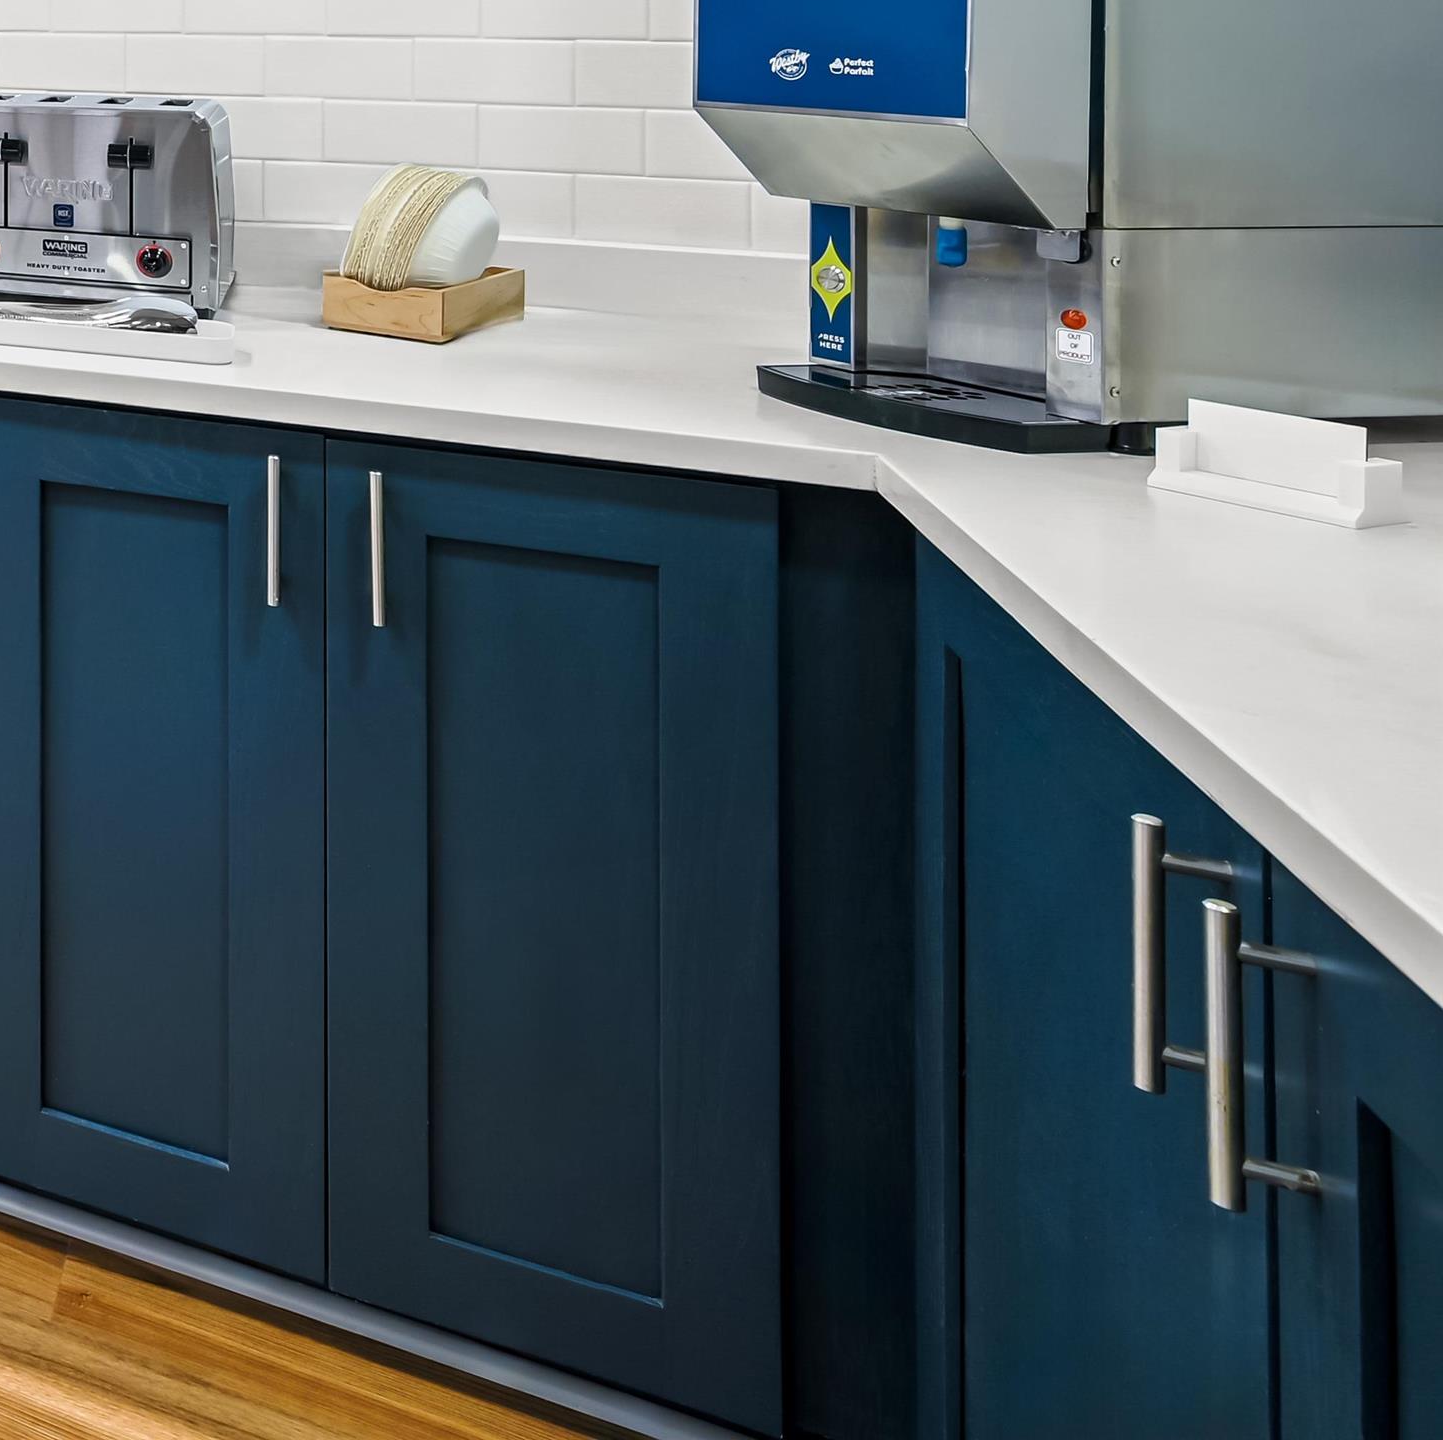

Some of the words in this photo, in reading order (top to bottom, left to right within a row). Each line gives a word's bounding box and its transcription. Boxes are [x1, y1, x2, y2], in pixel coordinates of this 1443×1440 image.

[843, 57, 875, 67] Perfect
[843, 66, 875, 76] Parfait
[21, 176, 115, 204] WARING
[44, 241, 87, 254] WARING
[42, 251, 88, 260] COMMERCIAL
[73, 266, 106, 274] TOASTER
[819, 340, 843, 351] HERE
